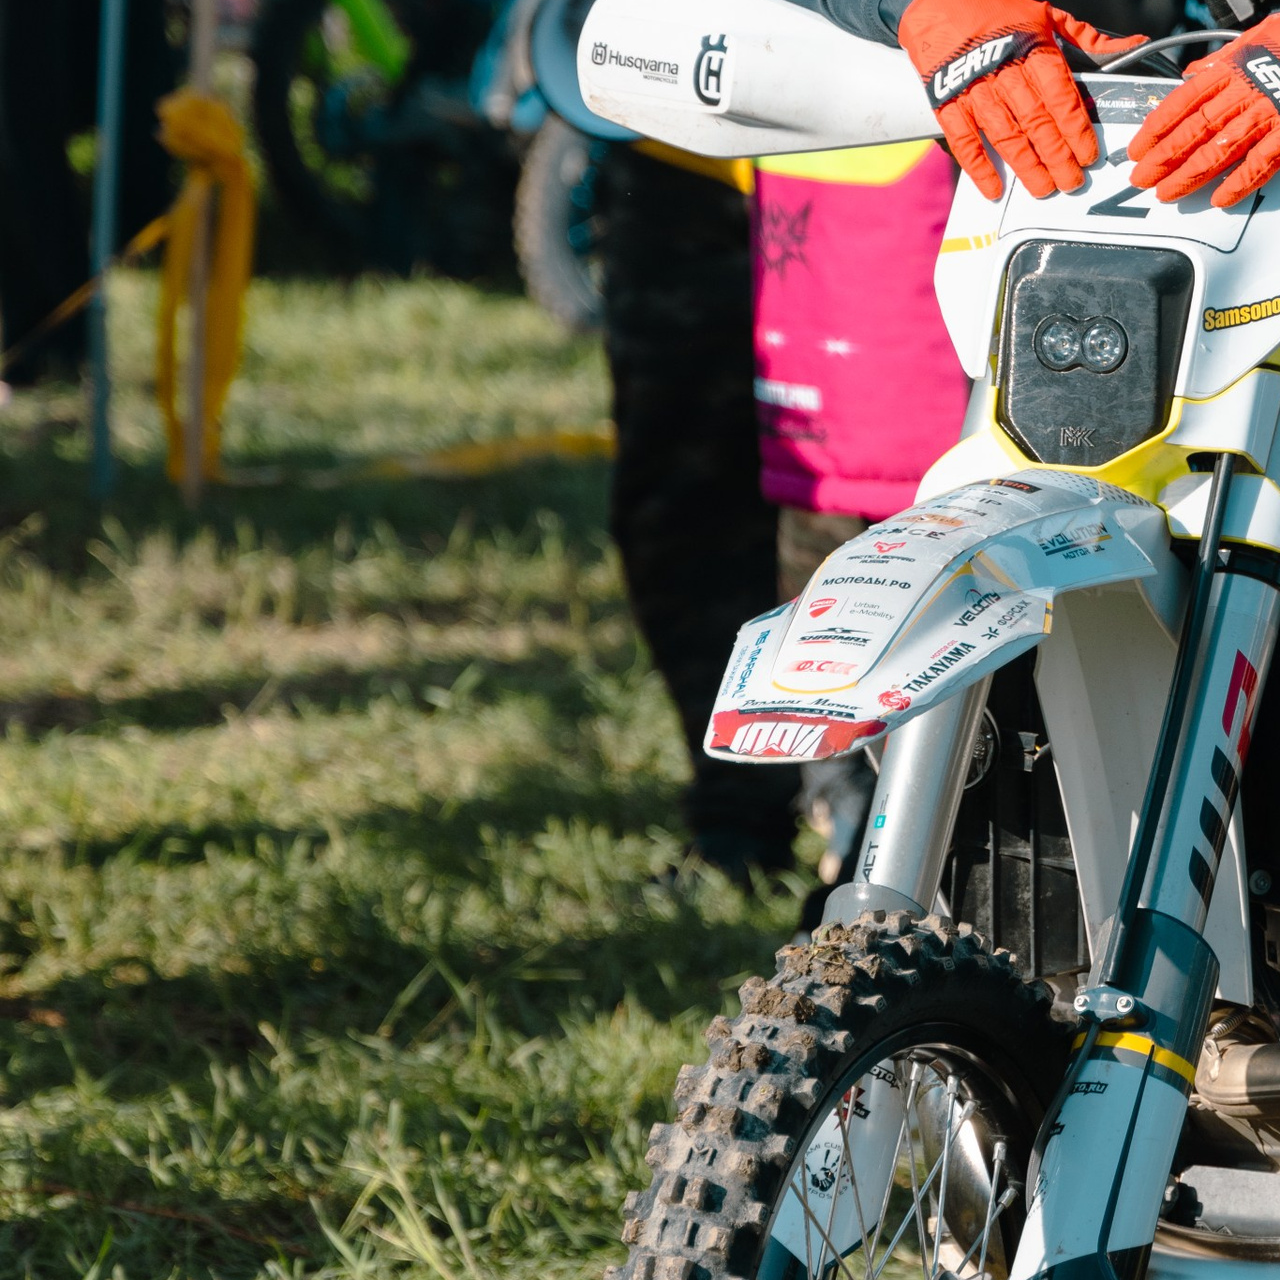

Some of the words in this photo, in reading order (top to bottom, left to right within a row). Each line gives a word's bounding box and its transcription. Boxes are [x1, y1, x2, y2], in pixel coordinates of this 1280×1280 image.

[608, 49, 679, 76] Husqvarna
[932, 34, 1015, 92] LEATT
[849, 608, 896, 621] e-Mobility
[853, 601, 881, 610] Urban
[953, 590, 1002, 629] VELOCITY
[902, 641, 977, 694] TAKAYAMA
